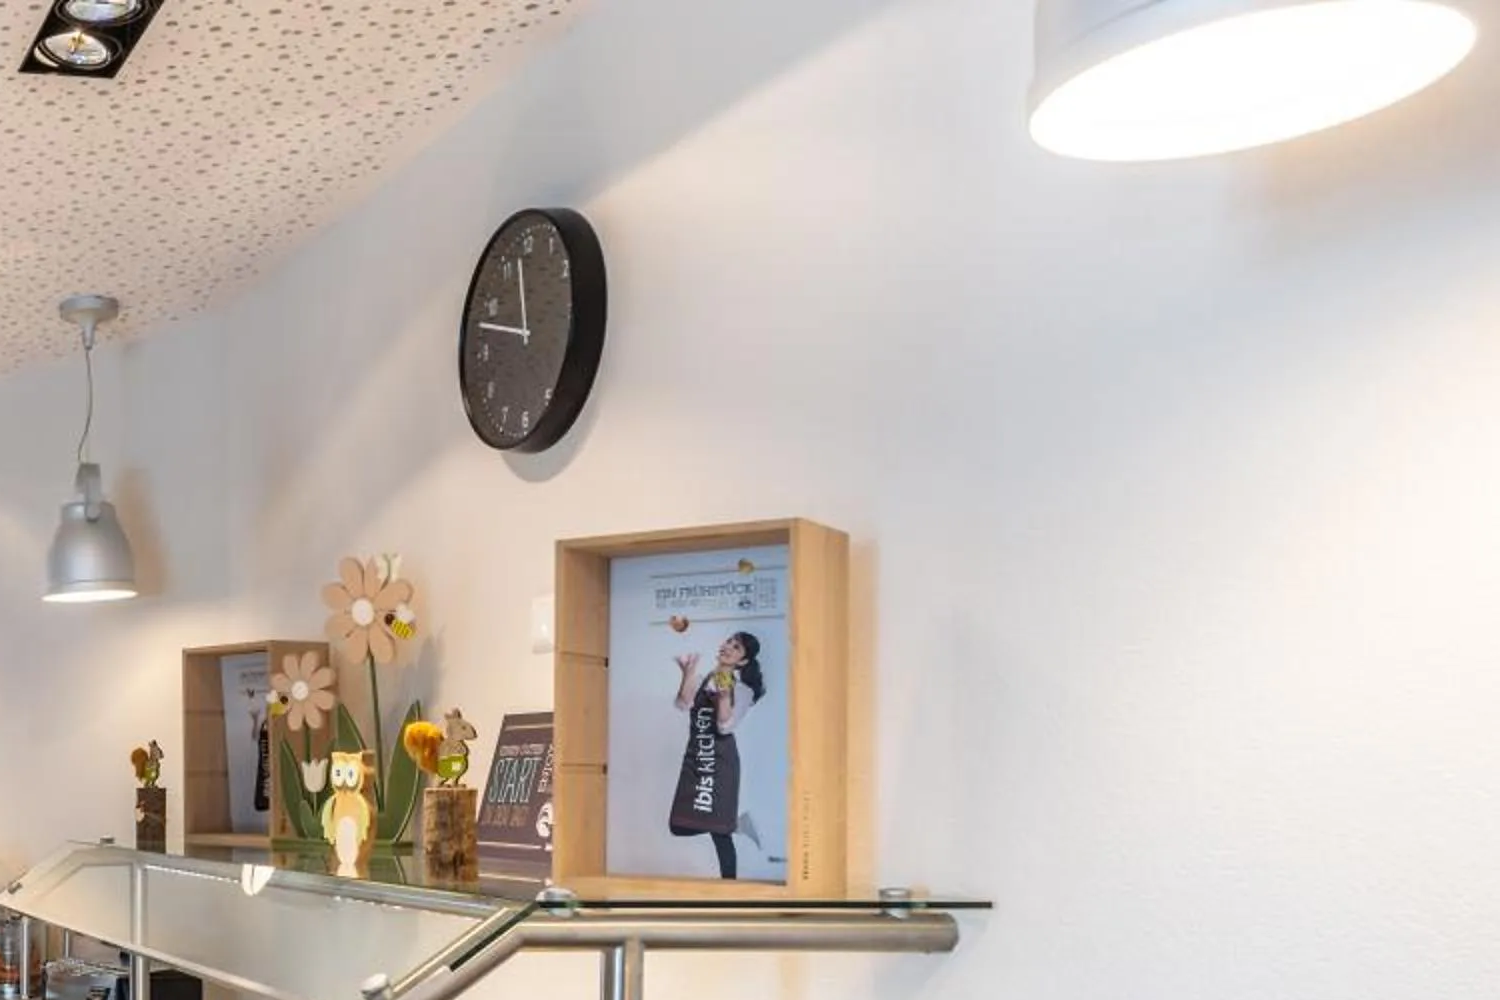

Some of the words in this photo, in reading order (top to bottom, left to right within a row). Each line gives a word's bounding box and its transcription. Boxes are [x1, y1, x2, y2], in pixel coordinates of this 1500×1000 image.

[523, 236, 534, 254] 12
[695, 706, 715, 774] kitchen
[487, 756, 542, 804] START
[693, 775, 714, 813] ibis
